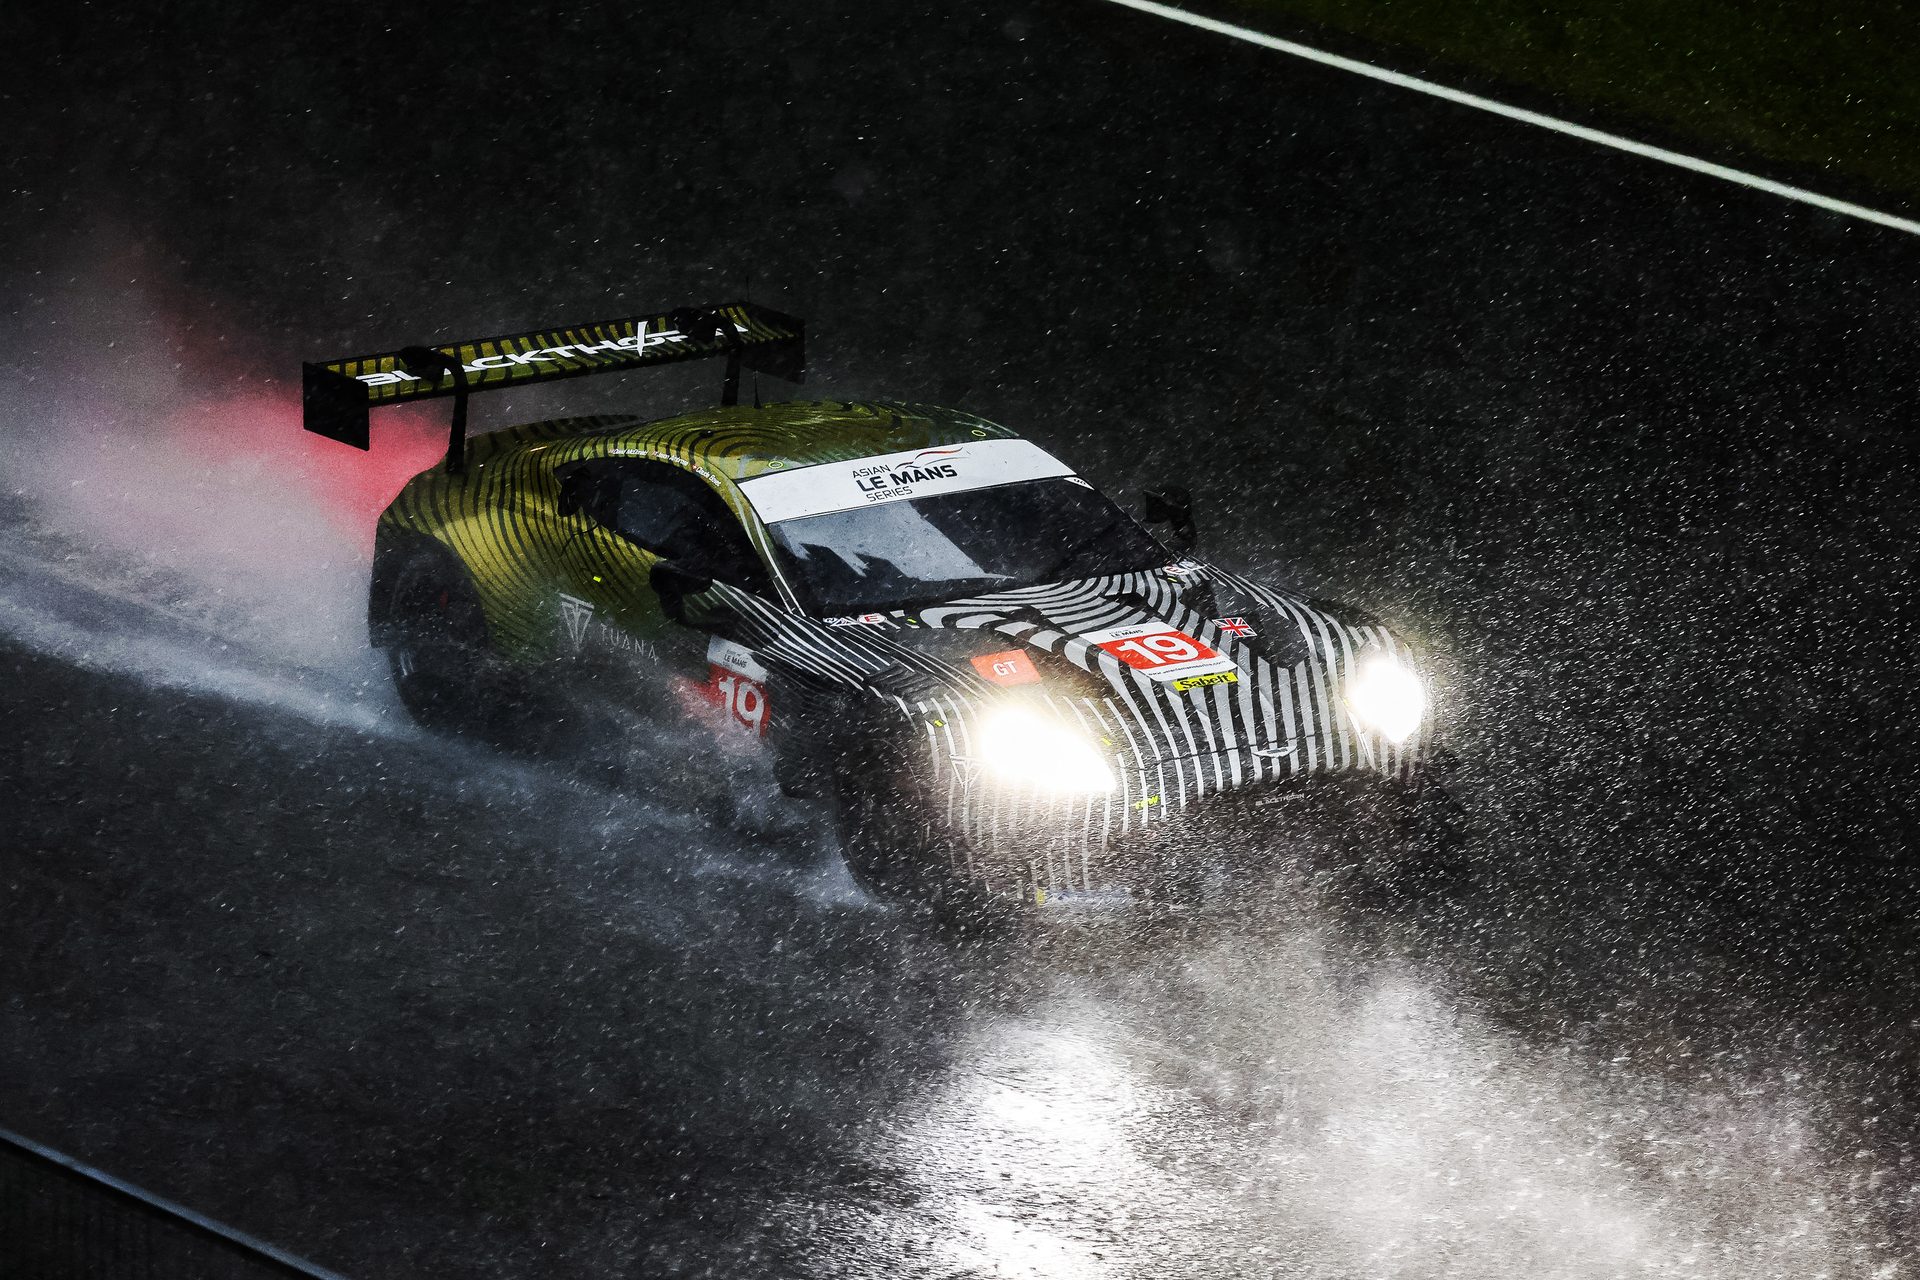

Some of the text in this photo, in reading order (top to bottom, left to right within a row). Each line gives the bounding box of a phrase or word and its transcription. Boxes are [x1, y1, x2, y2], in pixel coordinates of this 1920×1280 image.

[852, 464, 891, 479] ASIAN
[855, 464, 958, 492] LE MANS
[865, 486, 913, 503] SERIES
[599, 623, 659, 666] TUANA
[1116, 634, 1200, 665] 19
[992, 658, 1019, 678] GT
[1179, 674, 1230, 690] Sabelt
[718, 676, 764, 738] 19
